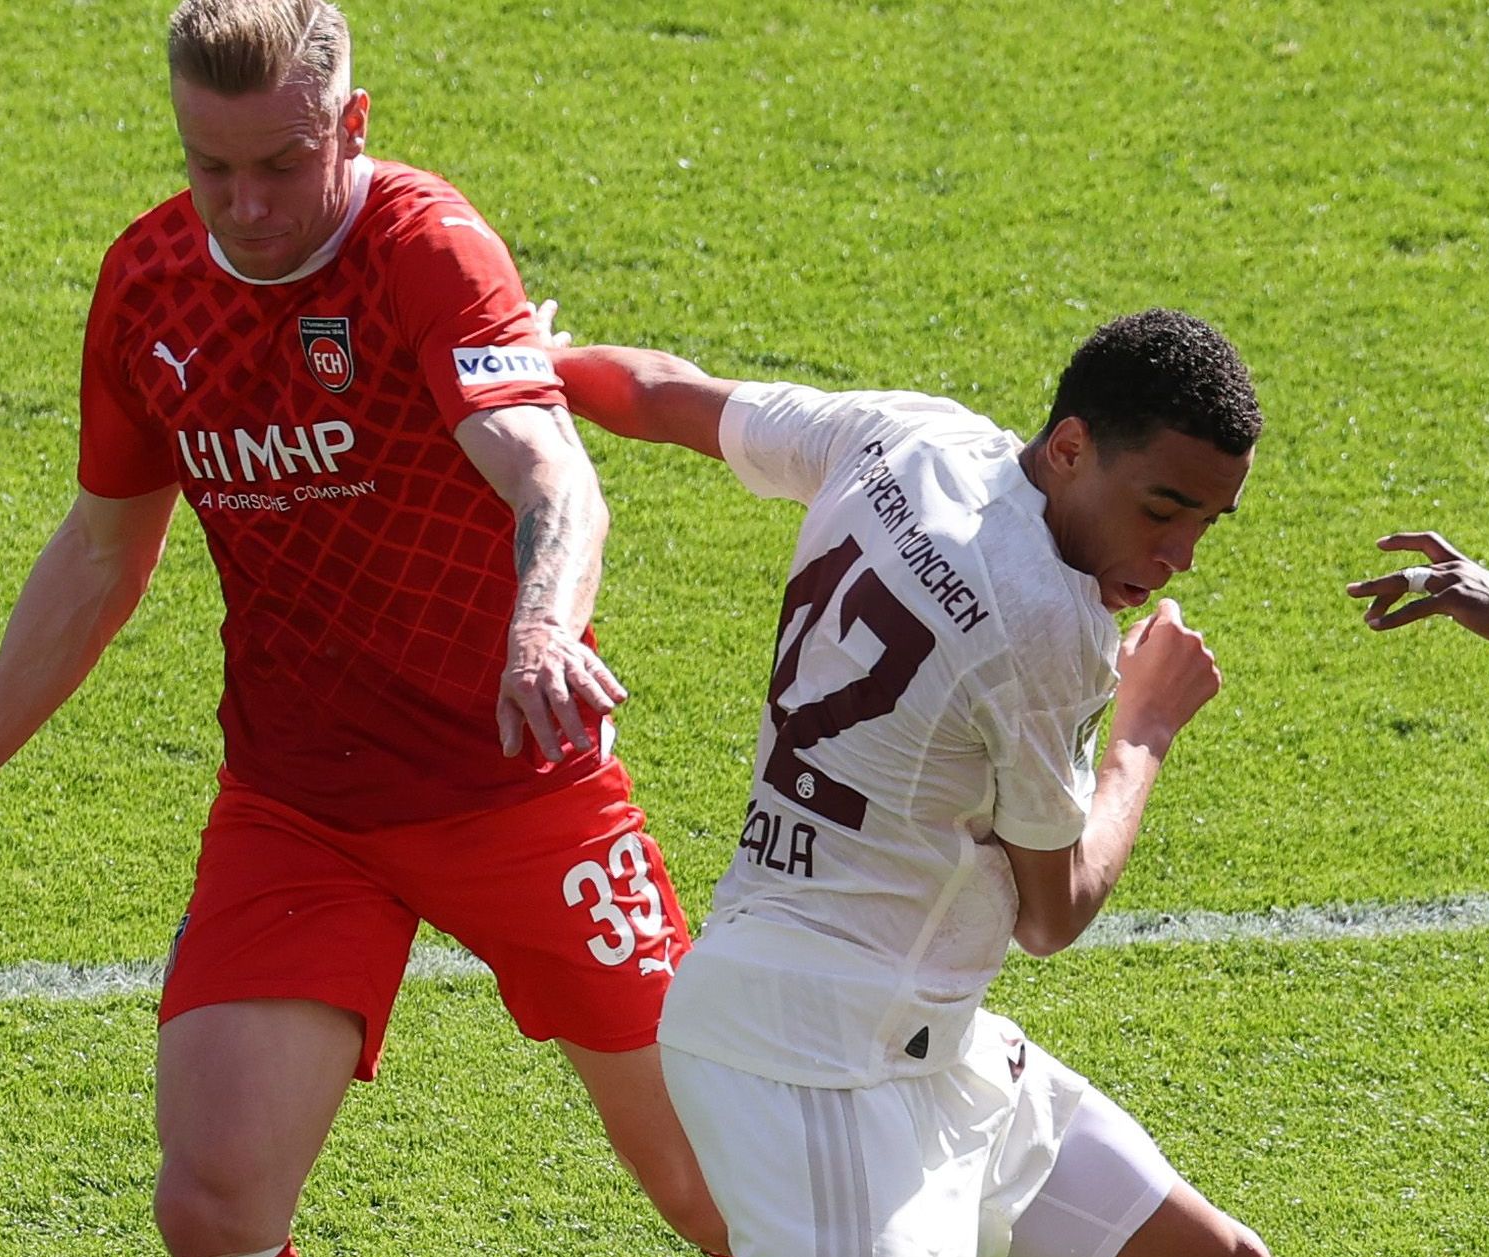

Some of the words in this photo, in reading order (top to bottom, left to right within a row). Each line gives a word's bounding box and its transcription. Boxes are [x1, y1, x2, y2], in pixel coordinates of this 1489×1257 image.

[313, 352, 344, 374] FCH
[458, 354, 549, 376] VOITH
[234, 420, 355, 482] MHP
[198, 491, 213, 509] A
[218, 491, 292, 512] PORSCHE
[293, 480, 377, 502] COMPANY
[894, 522, 990, 634] MÜNCHEN
[766, 533, 936, 832] 42
[562, 832, 663, 967] 33
